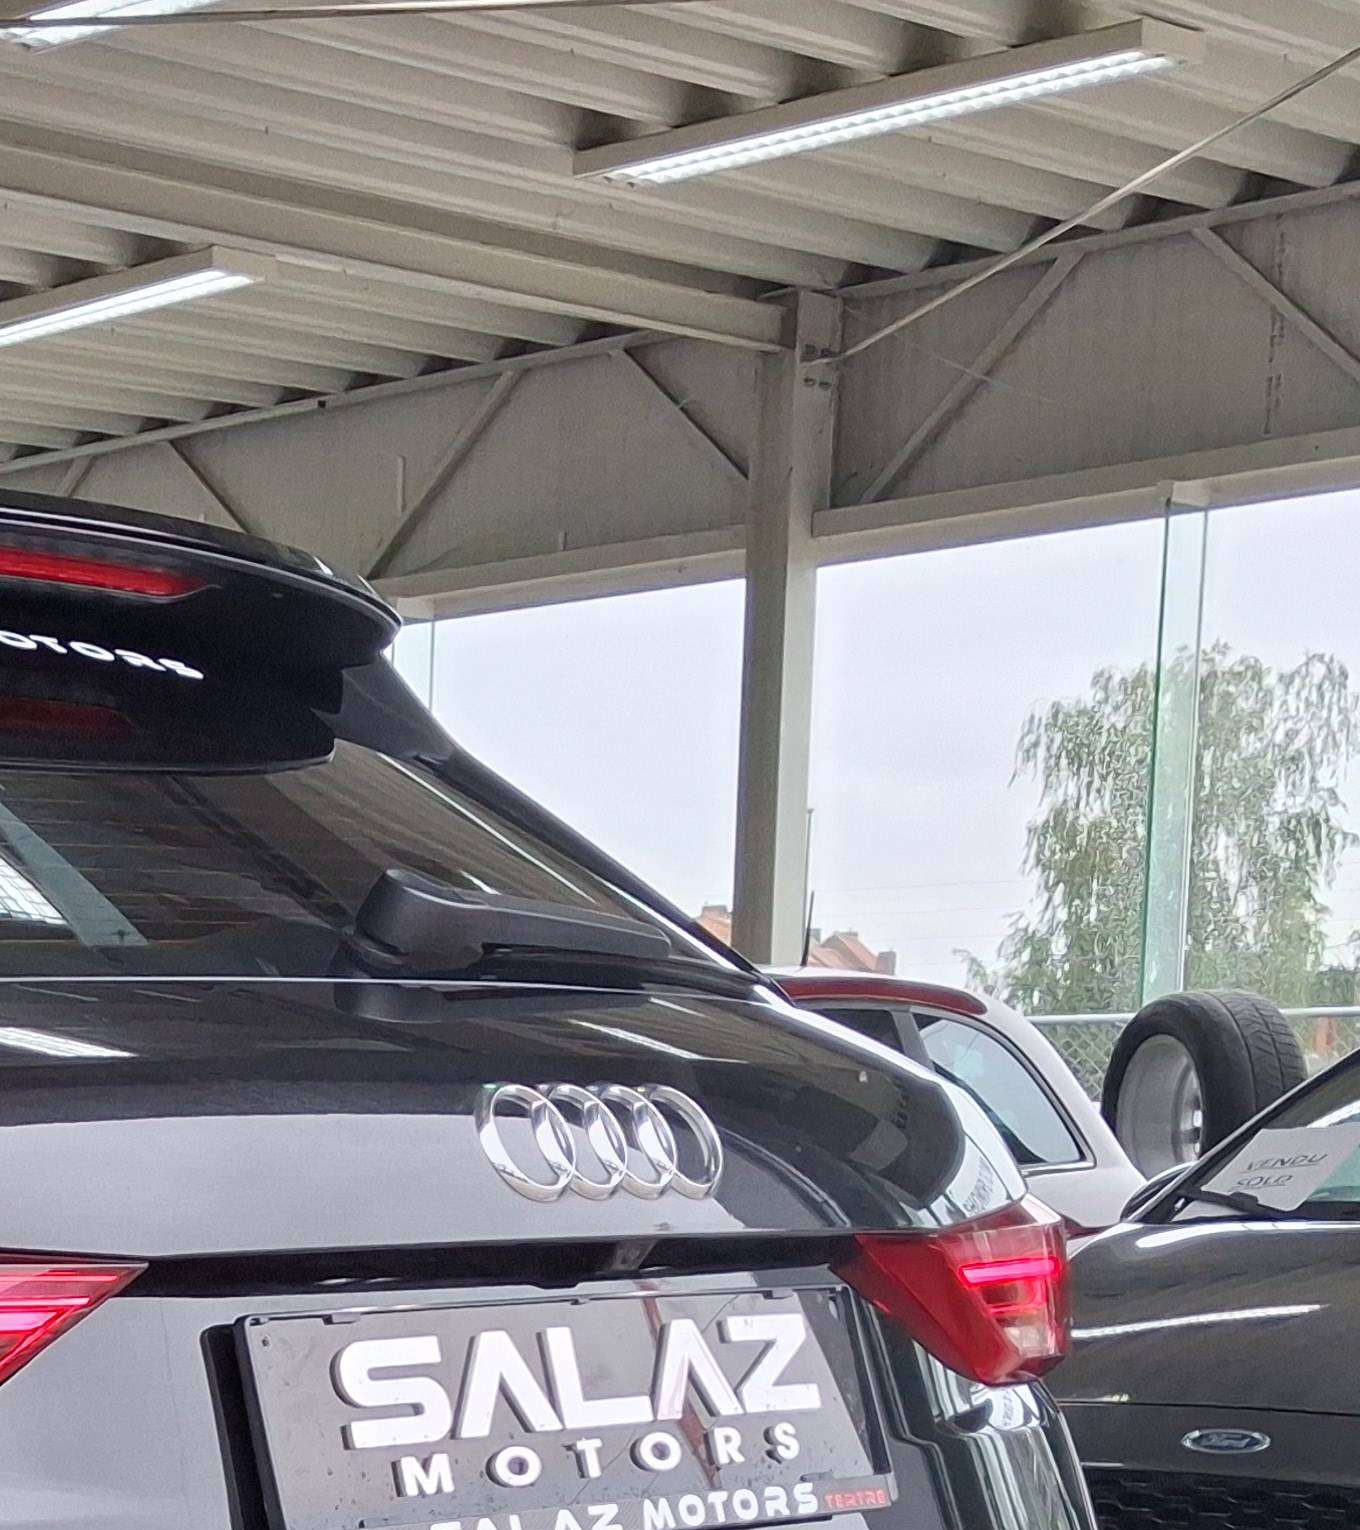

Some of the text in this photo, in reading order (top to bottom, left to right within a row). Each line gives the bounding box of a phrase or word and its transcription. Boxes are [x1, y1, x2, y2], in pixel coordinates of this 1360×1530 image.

[331, 1312, 822, 1450] SALAZ
[394, 1420, 802, 1498] MOTORS
[824, 1488, 888, 1508] TERTRE
